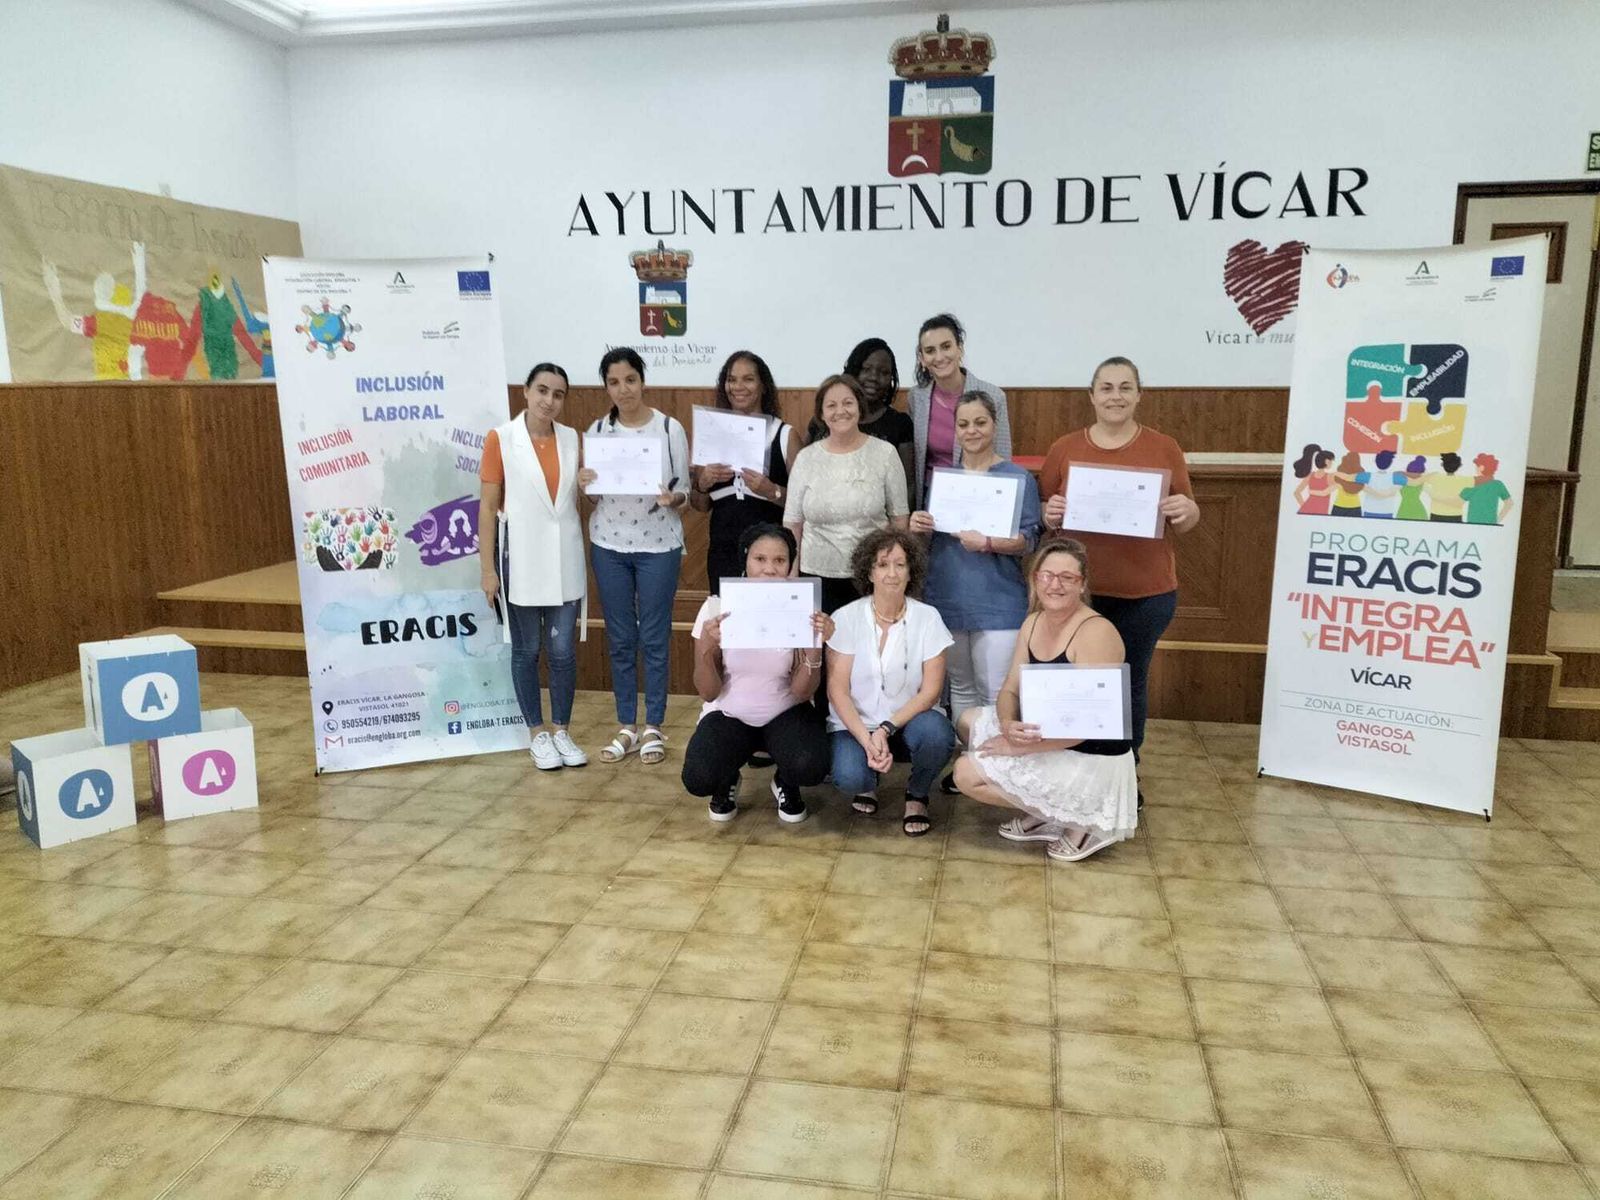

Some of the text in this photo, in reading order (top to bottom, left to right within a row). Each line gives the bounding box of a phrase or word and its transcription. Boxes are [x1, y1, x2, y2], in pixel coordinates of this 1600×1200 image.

[567, 160, 1370, 237] AYUNTAMIENTO DE VÍCAR
[356, 371, 445, 394] INCLUSIÓN
[1409, 350, 1465, 397] EMPLEABILIDAD
[362, 404, 445, 423] LABORAL
[297, 428, 354, 456] INCLUSIÓN
[298, 450, 371, 483] COMUNITARIA
[1309, 531, 1482, 561] PROGRAMA
[1306, 551, 1483, 599] ERACIS
[360, 612, 479, 646] ERACIS
[1350, 667, 1412, 691] VÍCAR
[1304, 697, 1342, 714] ZONA
[1345, 704, 1364, 716] DE
[501, 714, 525, 727] ERACIS
[1335, 719, 1416, 742] GANGOSA
[1336, 733, 1413, 756] VISTASOL
